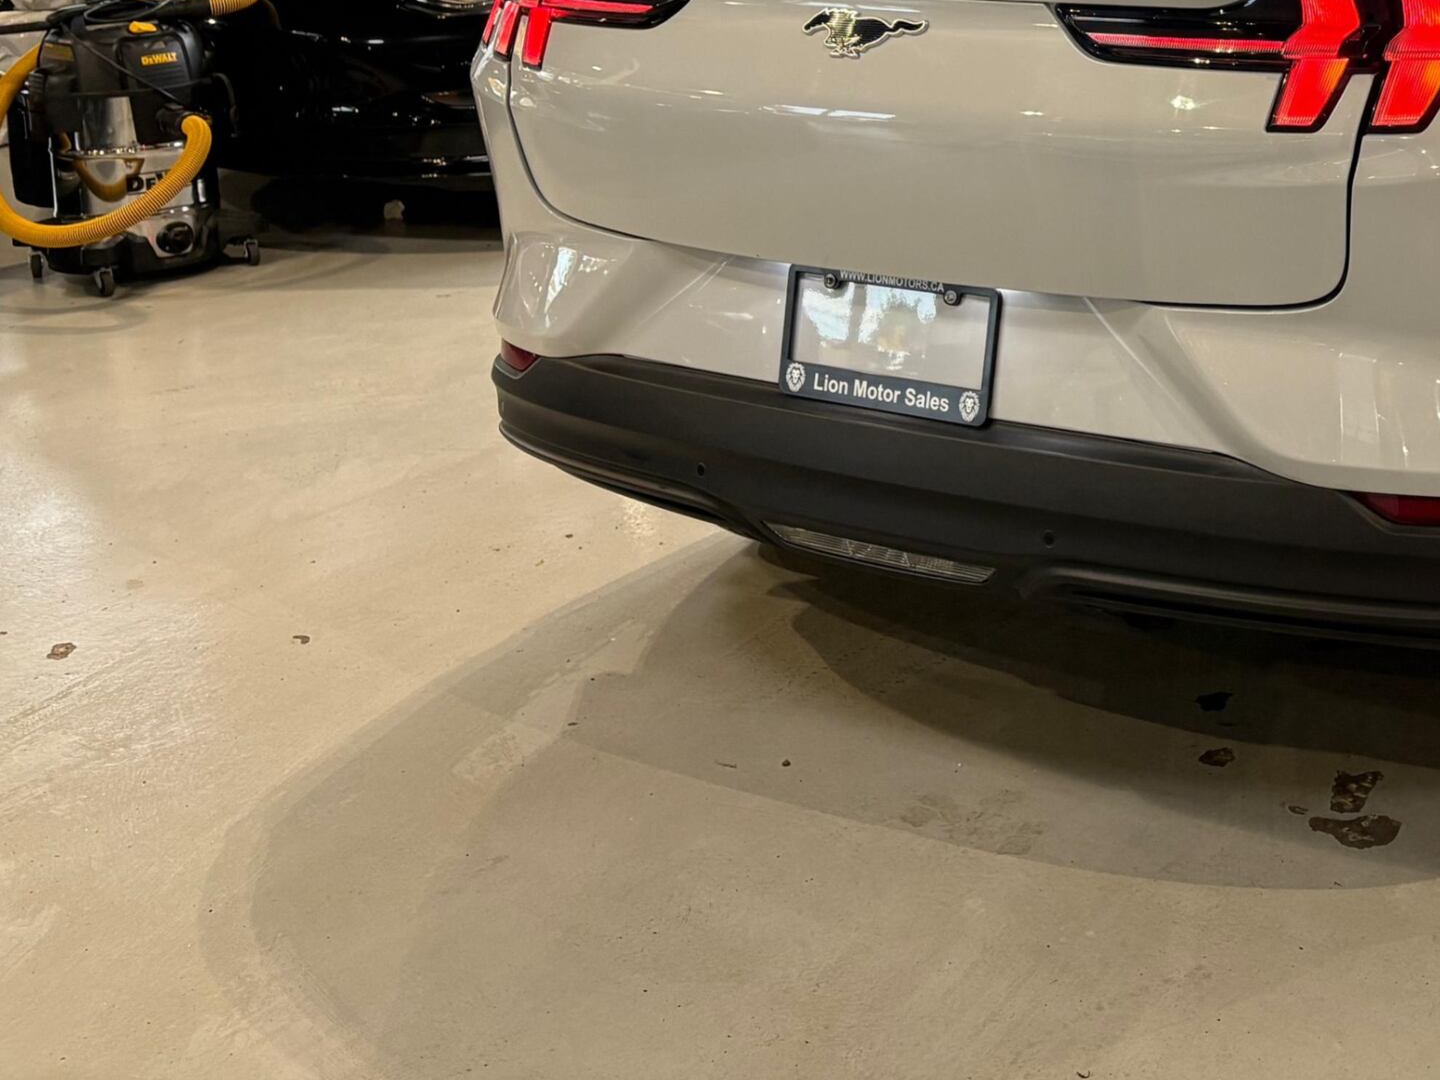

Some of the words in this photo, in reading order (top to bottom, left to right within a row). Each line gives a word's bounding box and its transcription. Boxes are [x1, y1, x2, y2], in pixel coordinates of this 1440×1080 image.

[839, 269, 946, 294] WWW.LIONMOTORS.CA
[812, 372, 849, 396] Lion
[852, 379, 901, 405] Motor
[904, 387, 950, 413] Sales
